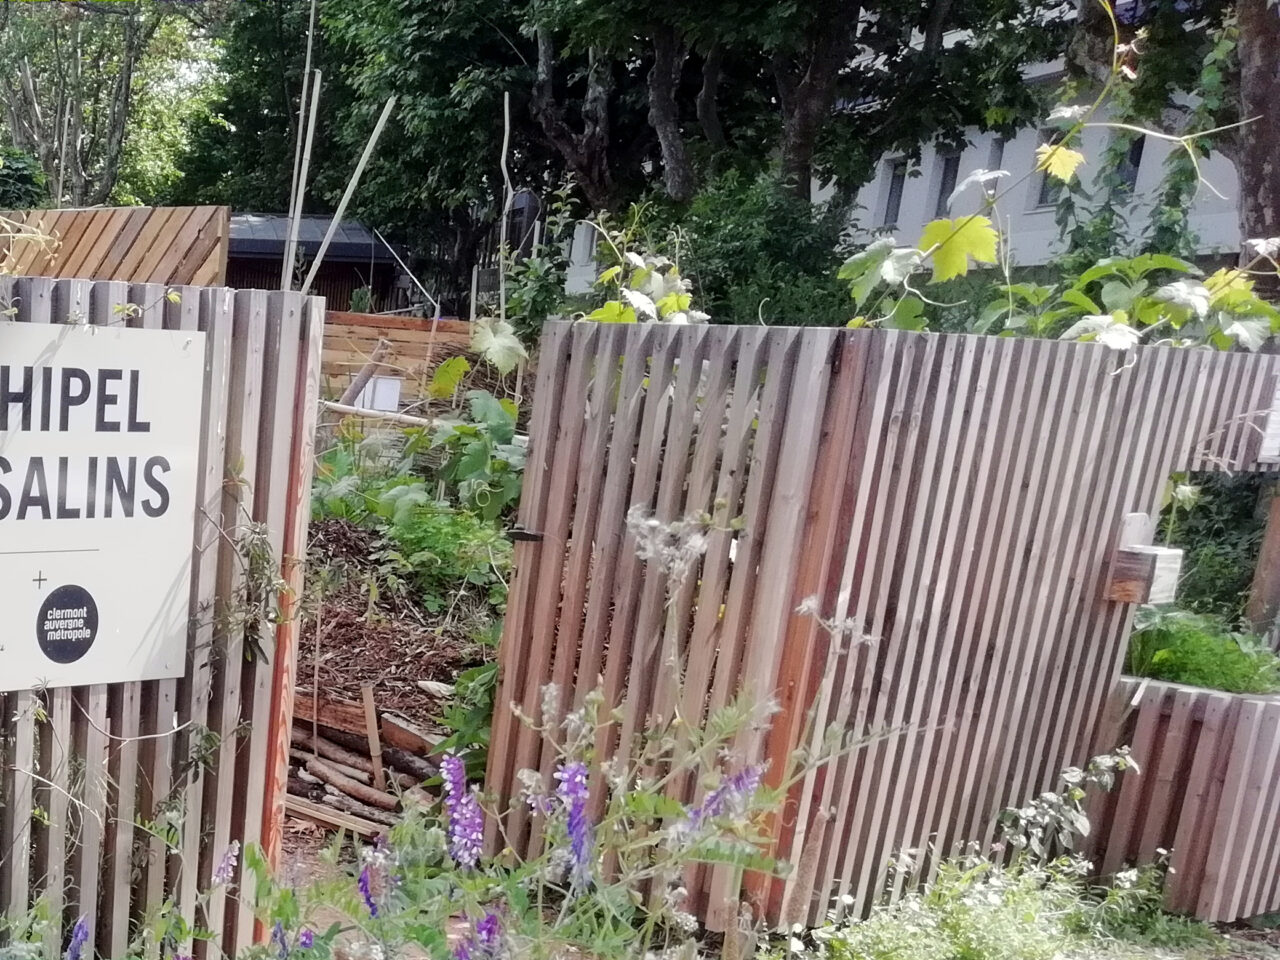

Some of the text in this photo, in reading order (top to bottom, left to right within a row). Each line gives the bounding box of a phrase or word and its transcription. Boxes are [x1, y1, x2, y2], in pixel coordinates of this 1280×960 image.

[47, 606, 87, 619] clermont
[43, 618, 84, 630] auvergne
[47, 626, 91, 641] métropole
